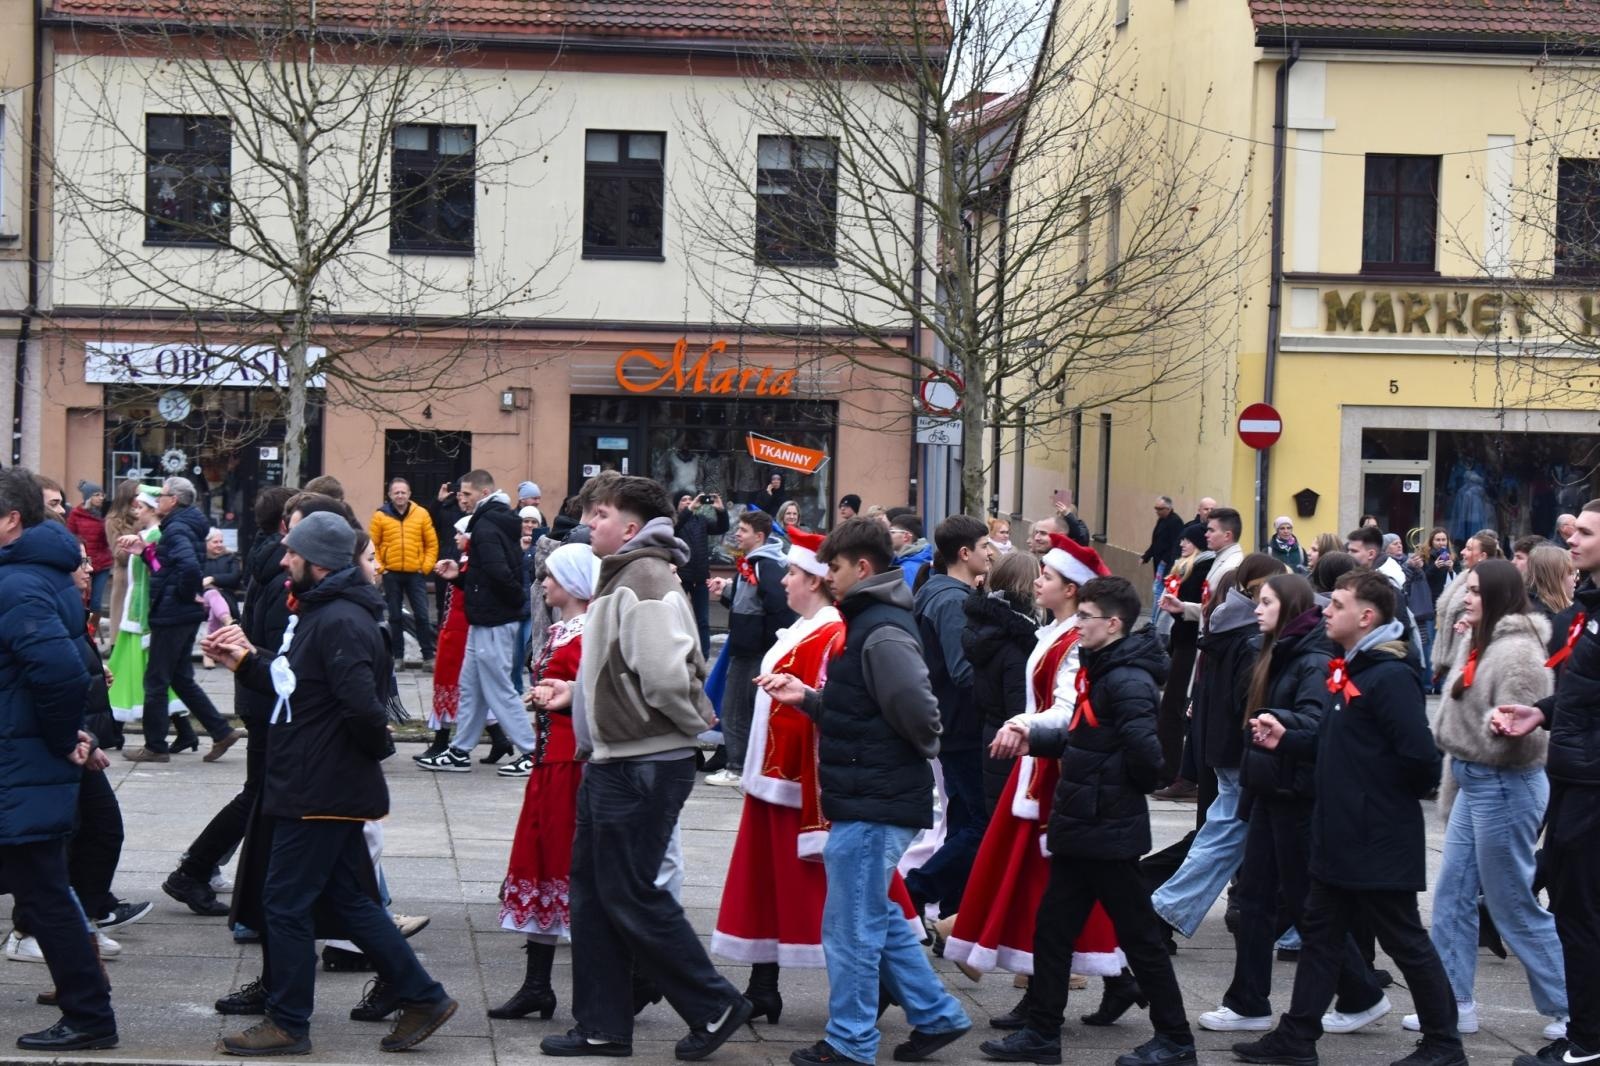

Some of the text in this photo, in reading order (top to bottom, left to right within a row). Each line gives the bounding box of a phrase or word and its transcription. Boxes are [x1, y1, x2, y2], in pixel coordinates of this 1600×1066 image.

[1323, 290, 1534, 335] MARKET
[1389, 380, 1399, 394] 5
[422, 404, 432, 419] 4
[759, 443, 812, 466] TKANINY
